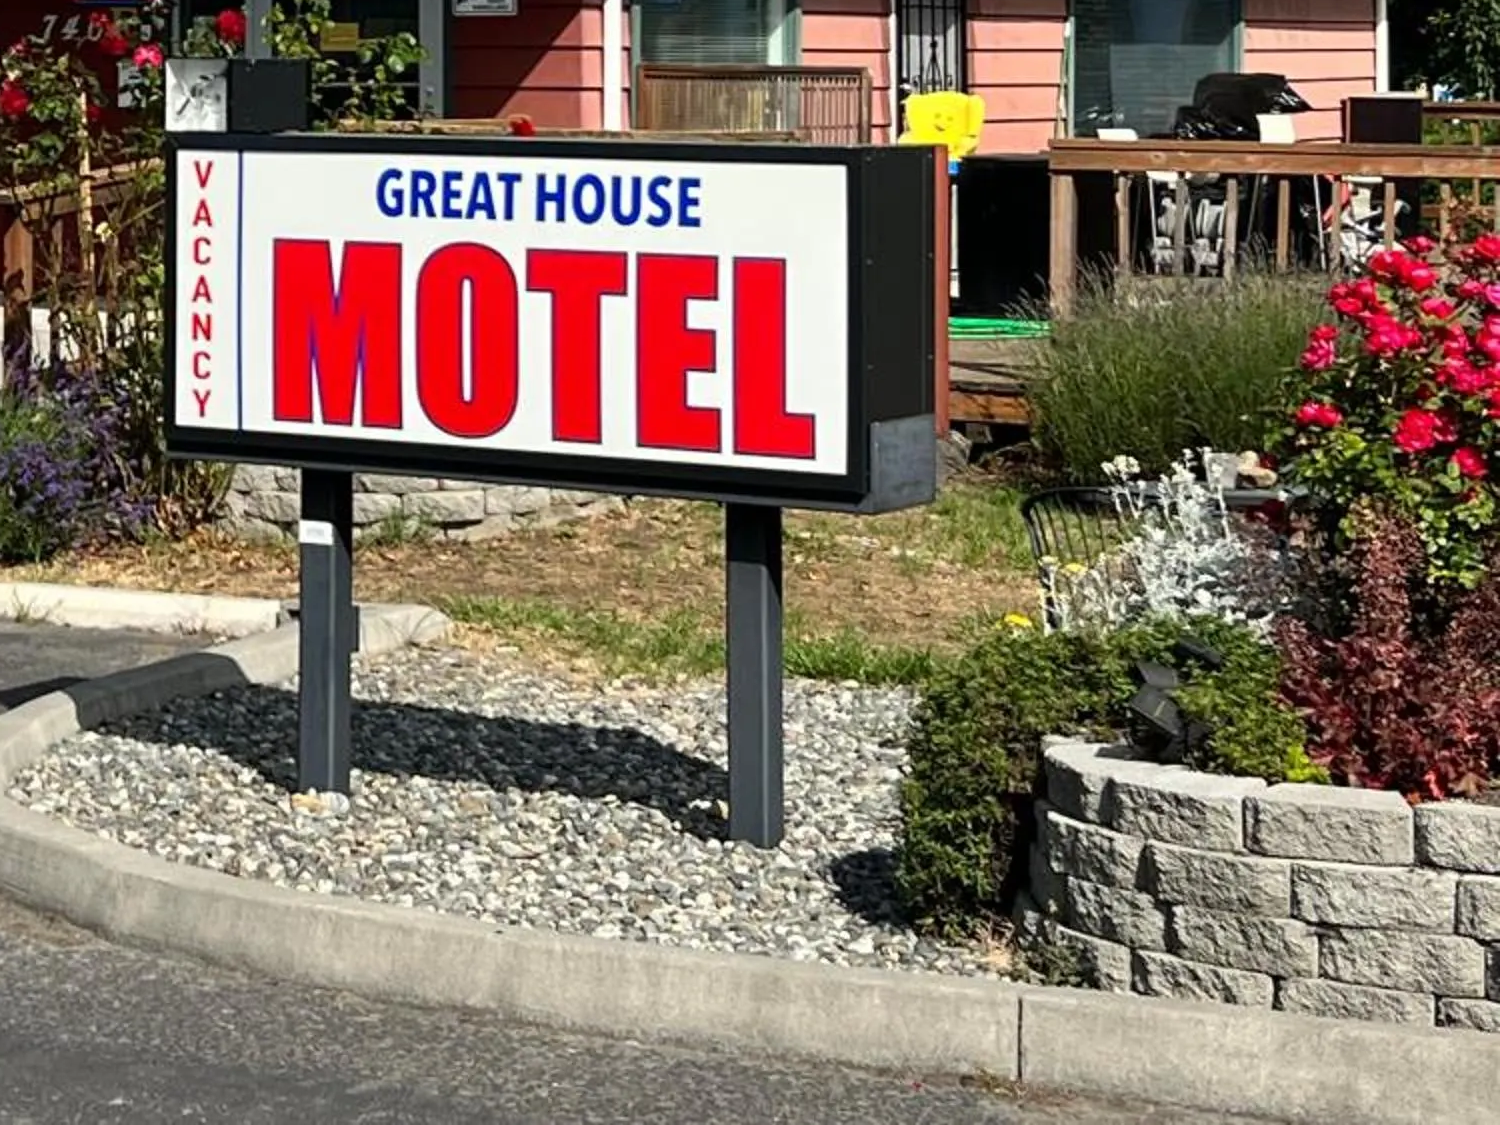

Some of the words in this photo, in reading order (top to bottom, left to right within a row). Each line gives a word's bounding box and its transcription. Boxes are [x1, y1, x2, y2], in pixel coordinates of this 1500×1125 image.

[192, 160, 214, 418] VACANCY
[376, 168, 518, 221] GREAT
[535, 174, 701, 227] HOUSE
[272, 237, 816, 461] MOTEL
